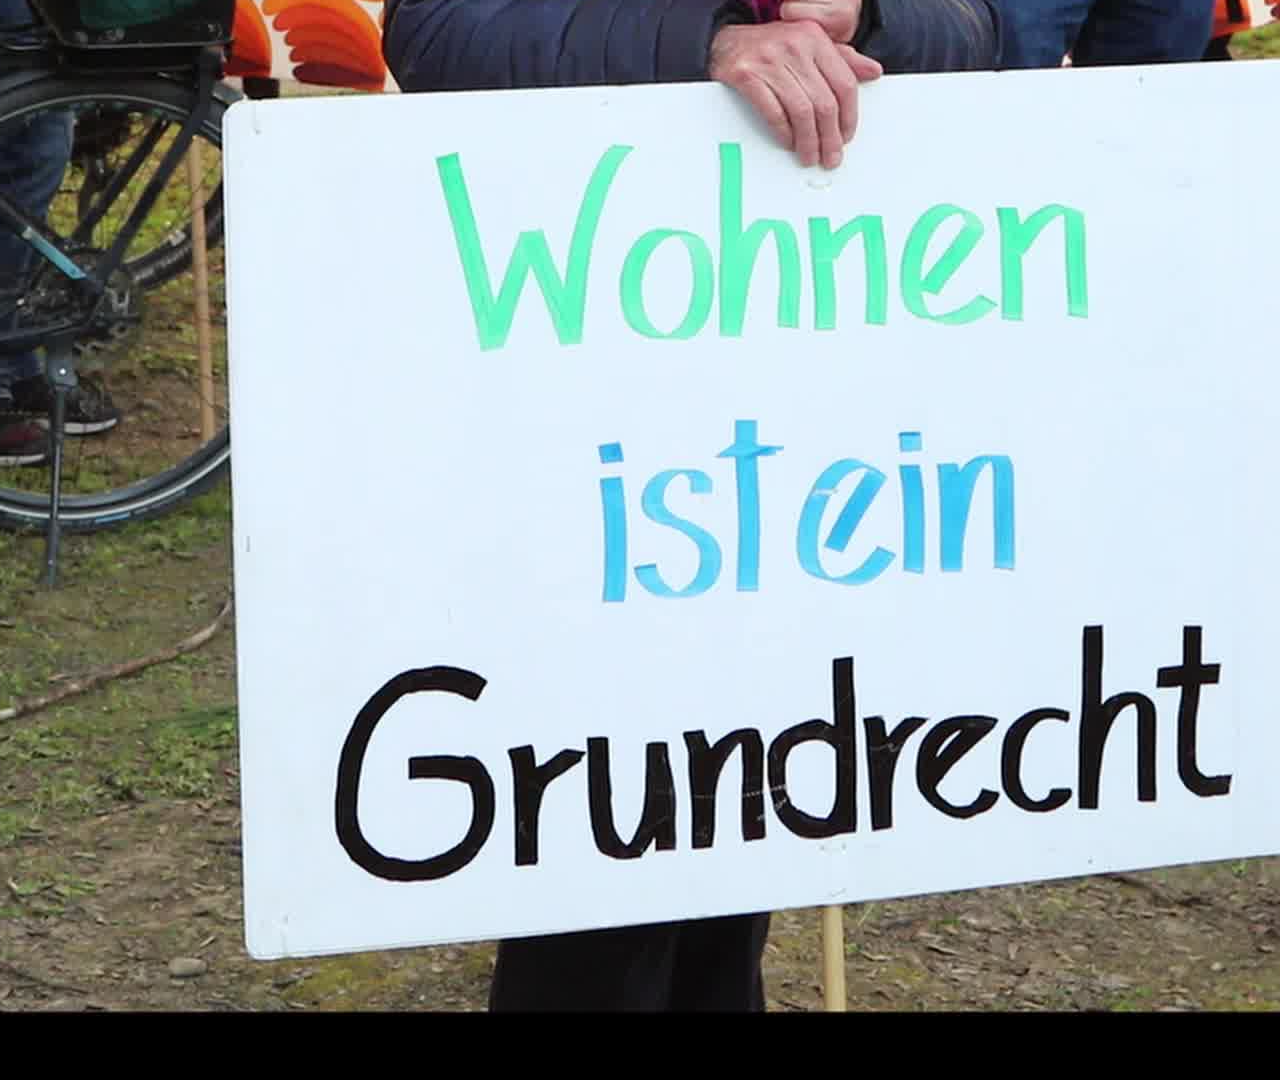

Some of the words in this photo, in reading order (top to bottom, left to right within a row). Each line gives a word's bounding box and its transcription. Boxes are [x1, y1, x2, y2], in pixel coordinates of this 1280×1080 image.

[436, 141, 1089, 351] Wohnen
[598, 420, 783, 602] ist
[797, 432, 1015, 584] ein
[334, 624, 1233, 884] Grundrecht
